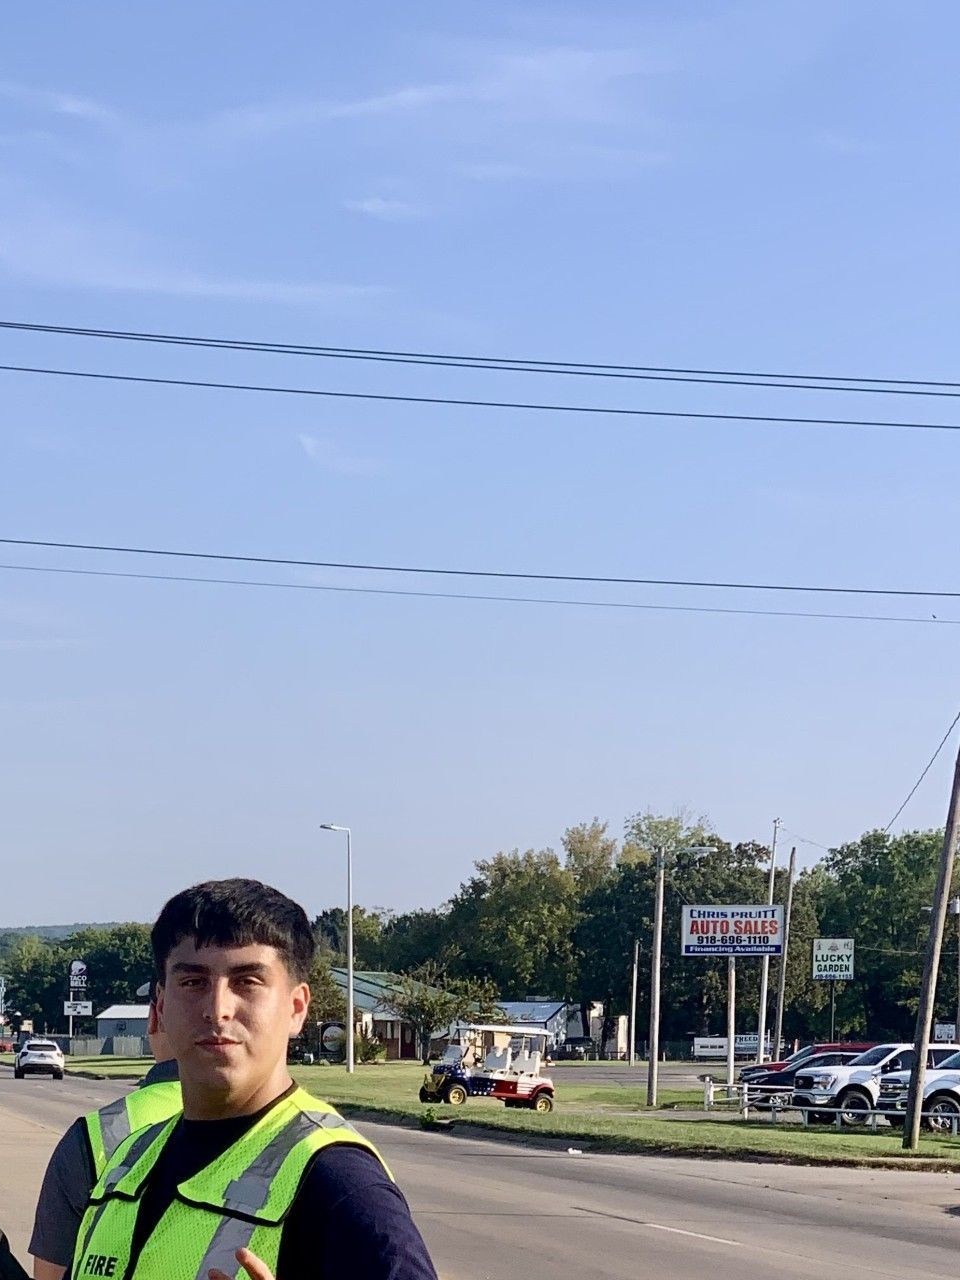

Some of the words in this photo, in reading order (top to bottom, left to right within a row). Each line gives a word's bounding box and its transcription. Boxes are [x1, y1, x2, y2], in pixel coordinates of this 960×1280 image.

[690, 909, 728, 919] CHRIS
[731, 909, 777, 919] PRUITT
[690, 920, 730, 935] AUTO
[733, 920, 778, 935] SALES
[697, 935, 769, 945] 918-696-1110
[689, 945, 733, 953] Financing
[815, 954, 852, 962] LUCKY
[817, 964, 850, 972] GARDEN
[84, 1254, 119, 1277] FIRE
